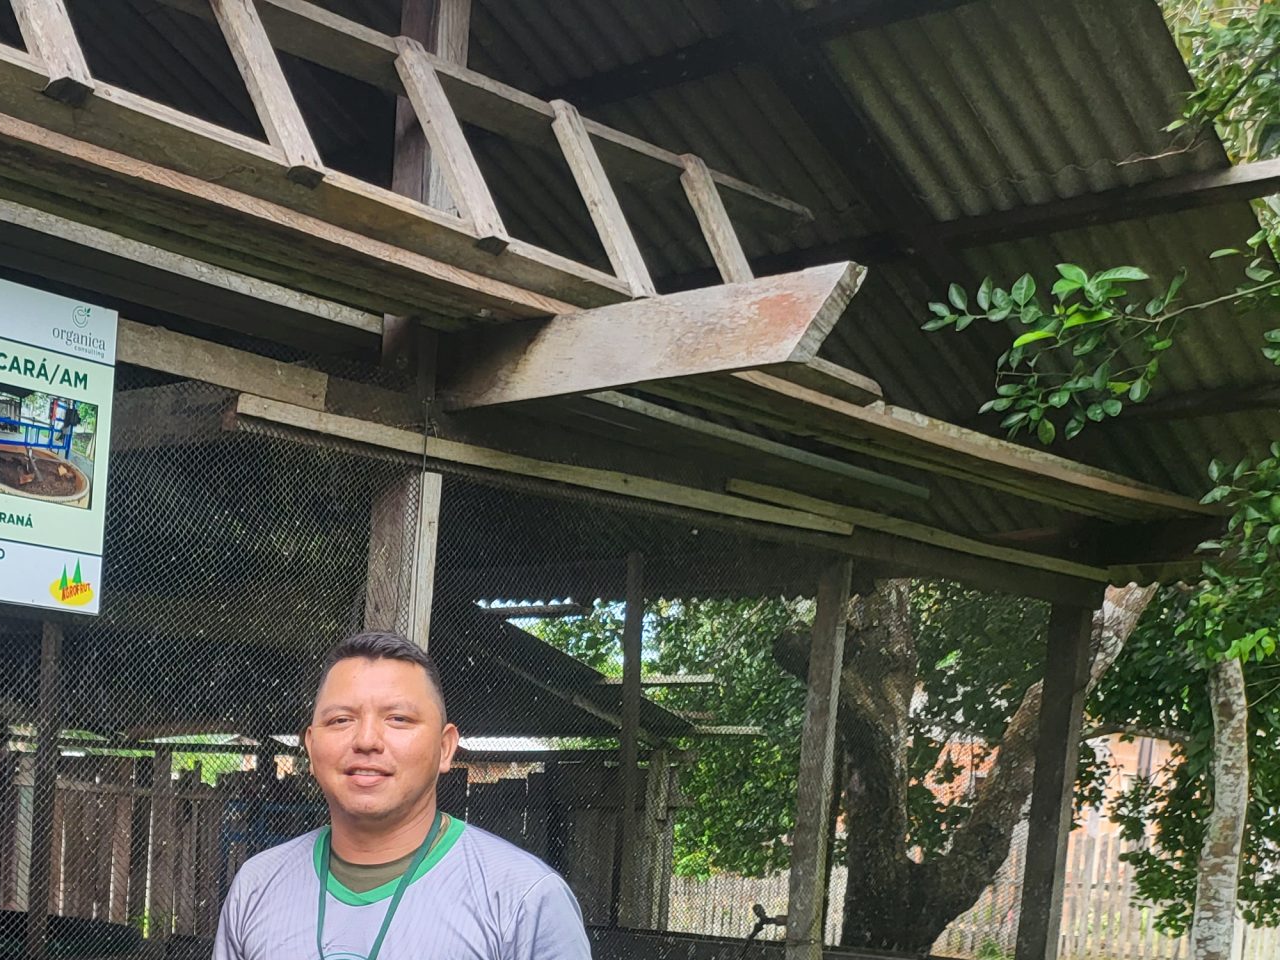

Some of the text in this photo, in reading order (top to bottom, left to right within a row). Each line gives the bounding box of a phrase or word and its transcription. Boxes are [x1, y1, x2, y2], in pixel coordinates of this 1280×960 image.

[52, 327, 106, 351] organica
[74, 345, 105, 359] consulting
[61, 582, 91, 601] AGROFRUT
